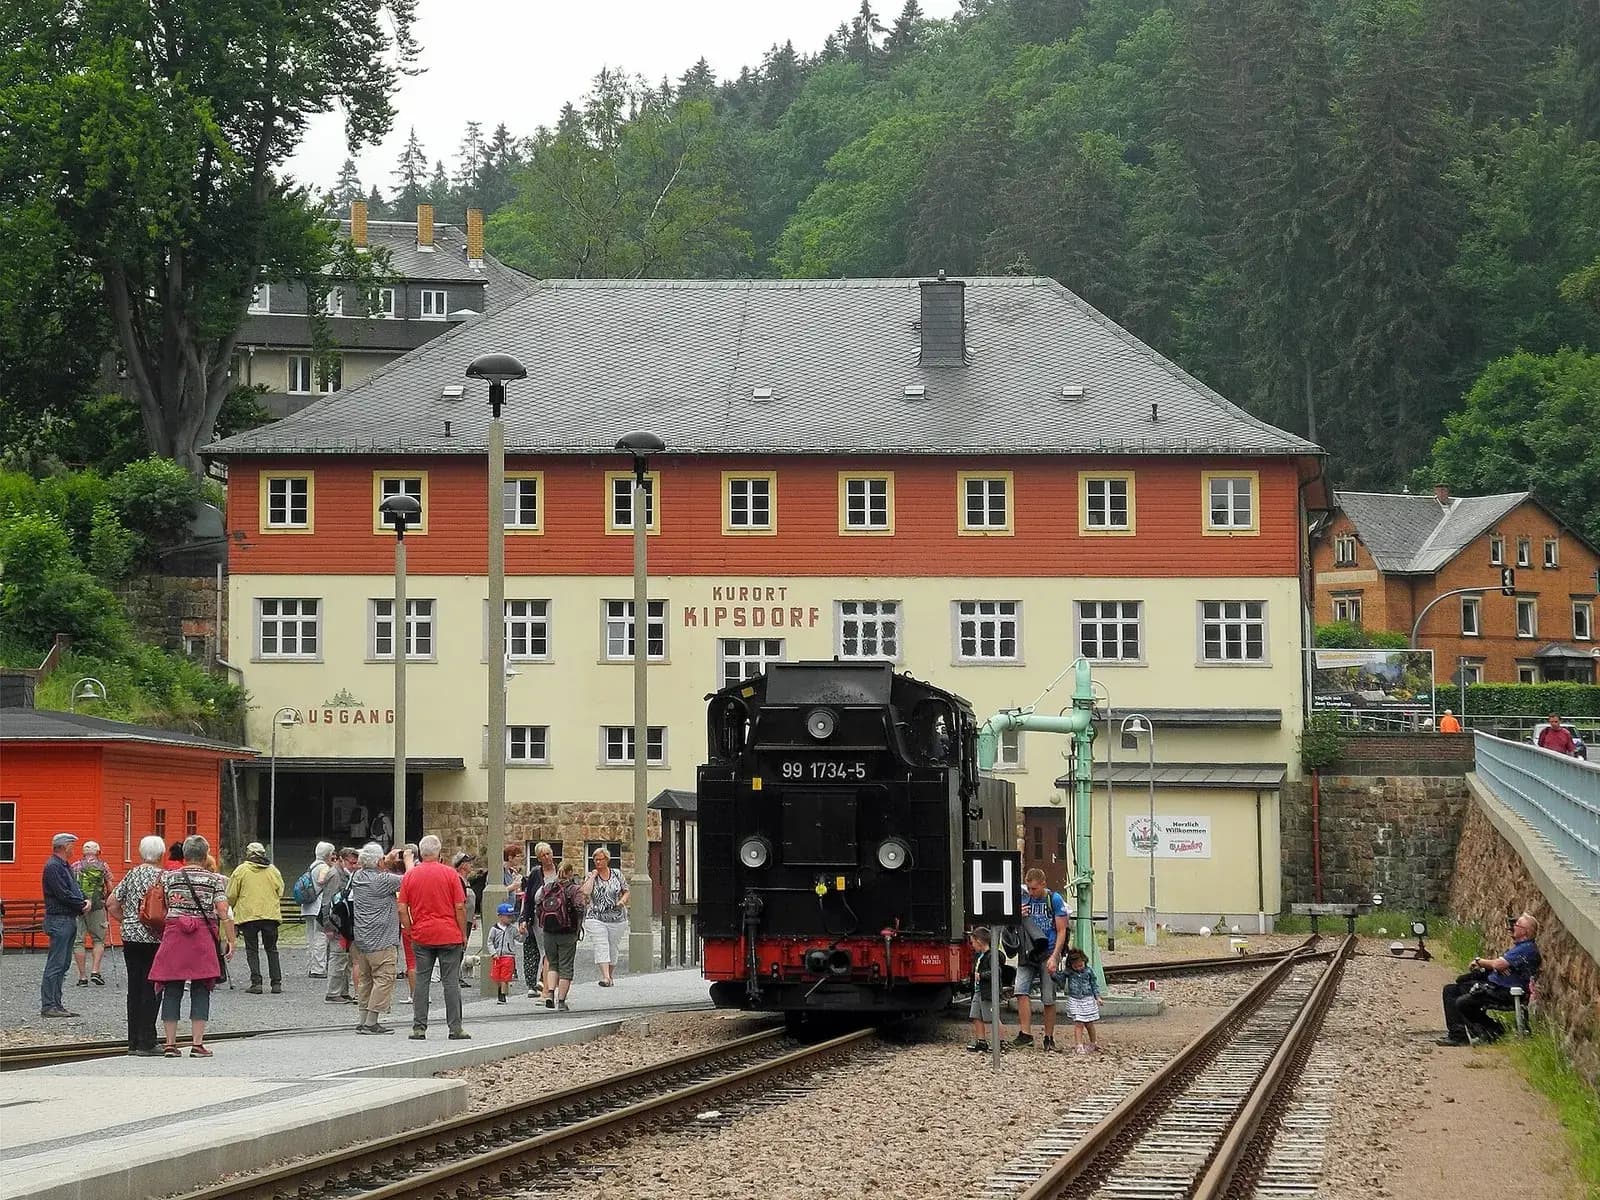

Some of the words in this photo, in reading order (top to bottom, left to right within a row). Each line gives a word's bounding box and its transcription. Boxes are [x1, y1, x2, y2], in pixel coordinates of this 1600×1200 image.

[712, 586, 788, 602] KURORT
[684, 606, 821, 628] KIPSDORF
[782, 762, 803, 778] 99
[810, 762, 866, 778] 1734-5
[972, 859, 1013, 916] H
